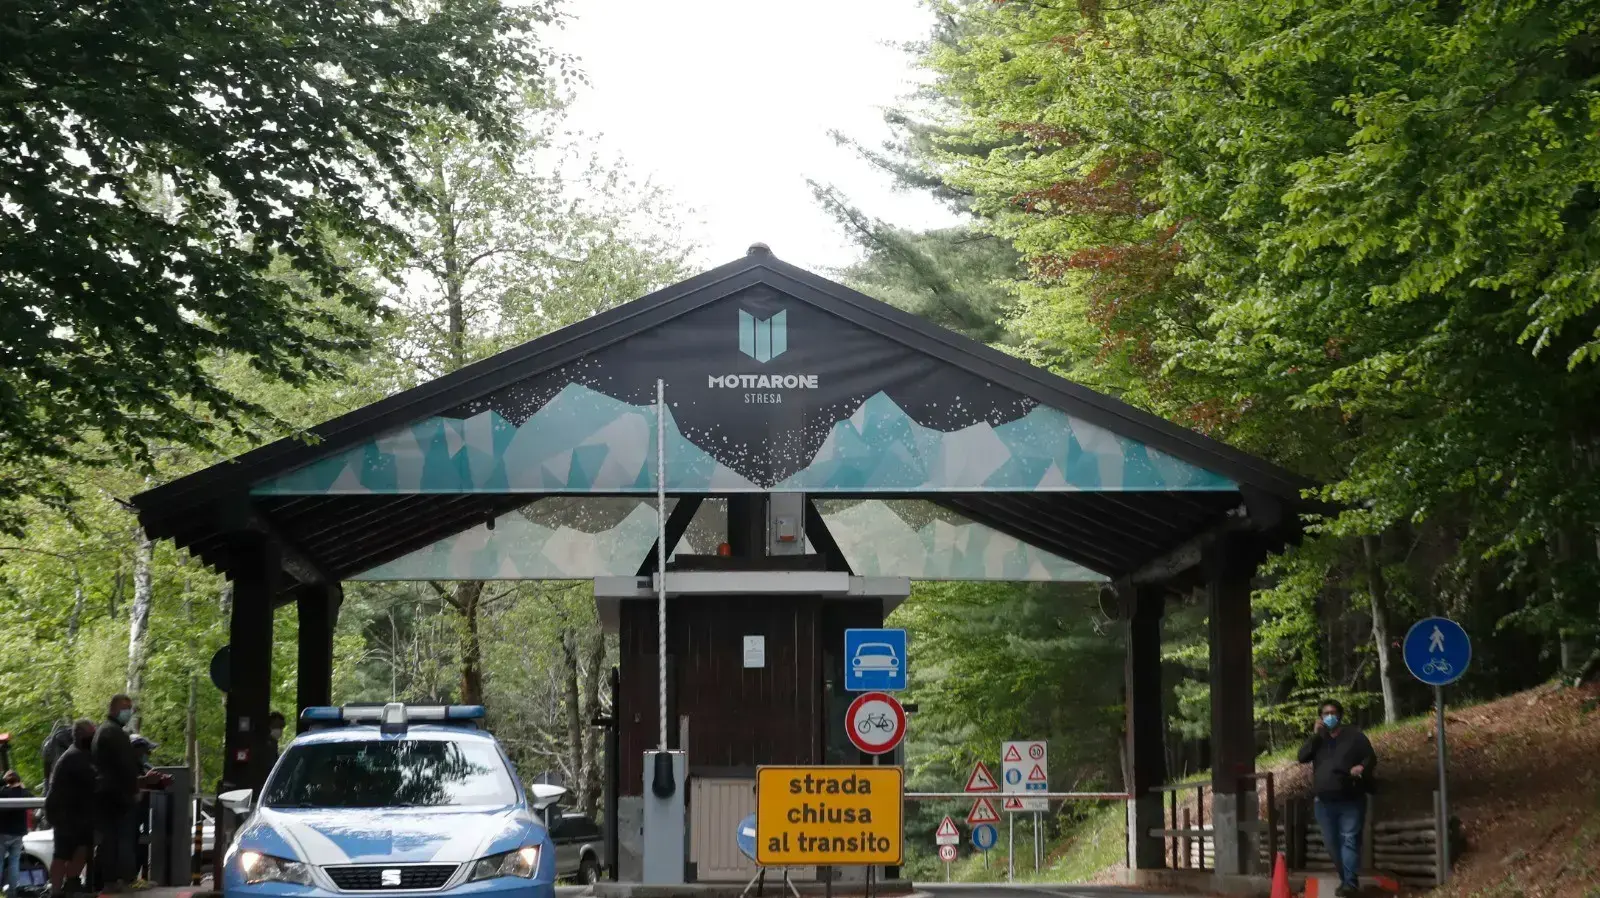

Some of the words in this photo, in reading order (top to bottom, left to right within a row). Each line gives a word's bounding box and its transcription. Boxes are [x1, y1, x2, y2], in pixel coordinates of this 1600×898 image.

[708, 374, 819, 389] MOTTARONE
[744, 393, 782, 404] STRESA
[789, 773, 872, 795] strada
[787, 802, 872, 824] chiusa
[768, 832, 790, 853] al
[797, 831, 891, 853] transito
